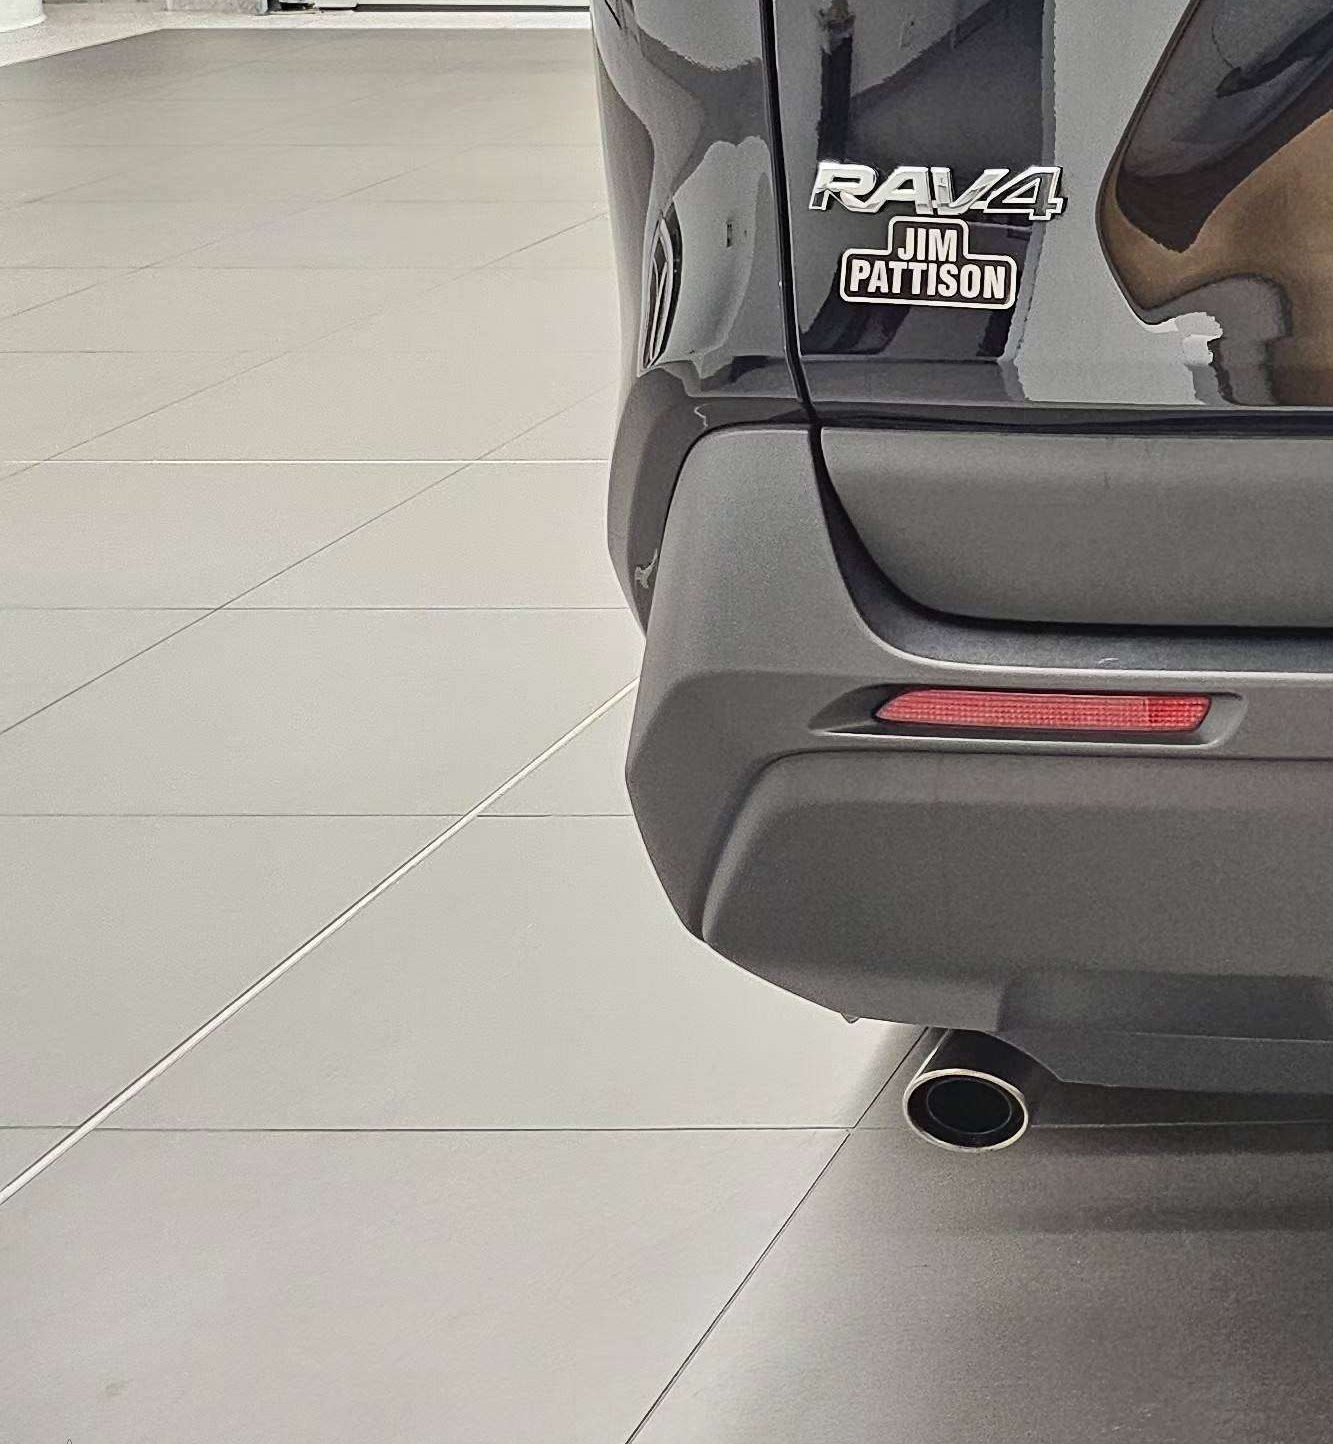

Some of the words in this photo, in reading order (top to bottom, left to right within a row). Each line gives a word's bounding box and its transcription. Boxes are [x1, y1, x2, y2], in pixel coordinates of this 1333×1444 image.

[809, 160, 1064, 220] RAV4
[898, 227, 958, 262] JIM
[850, 258, 1006, 299] PATTISON
